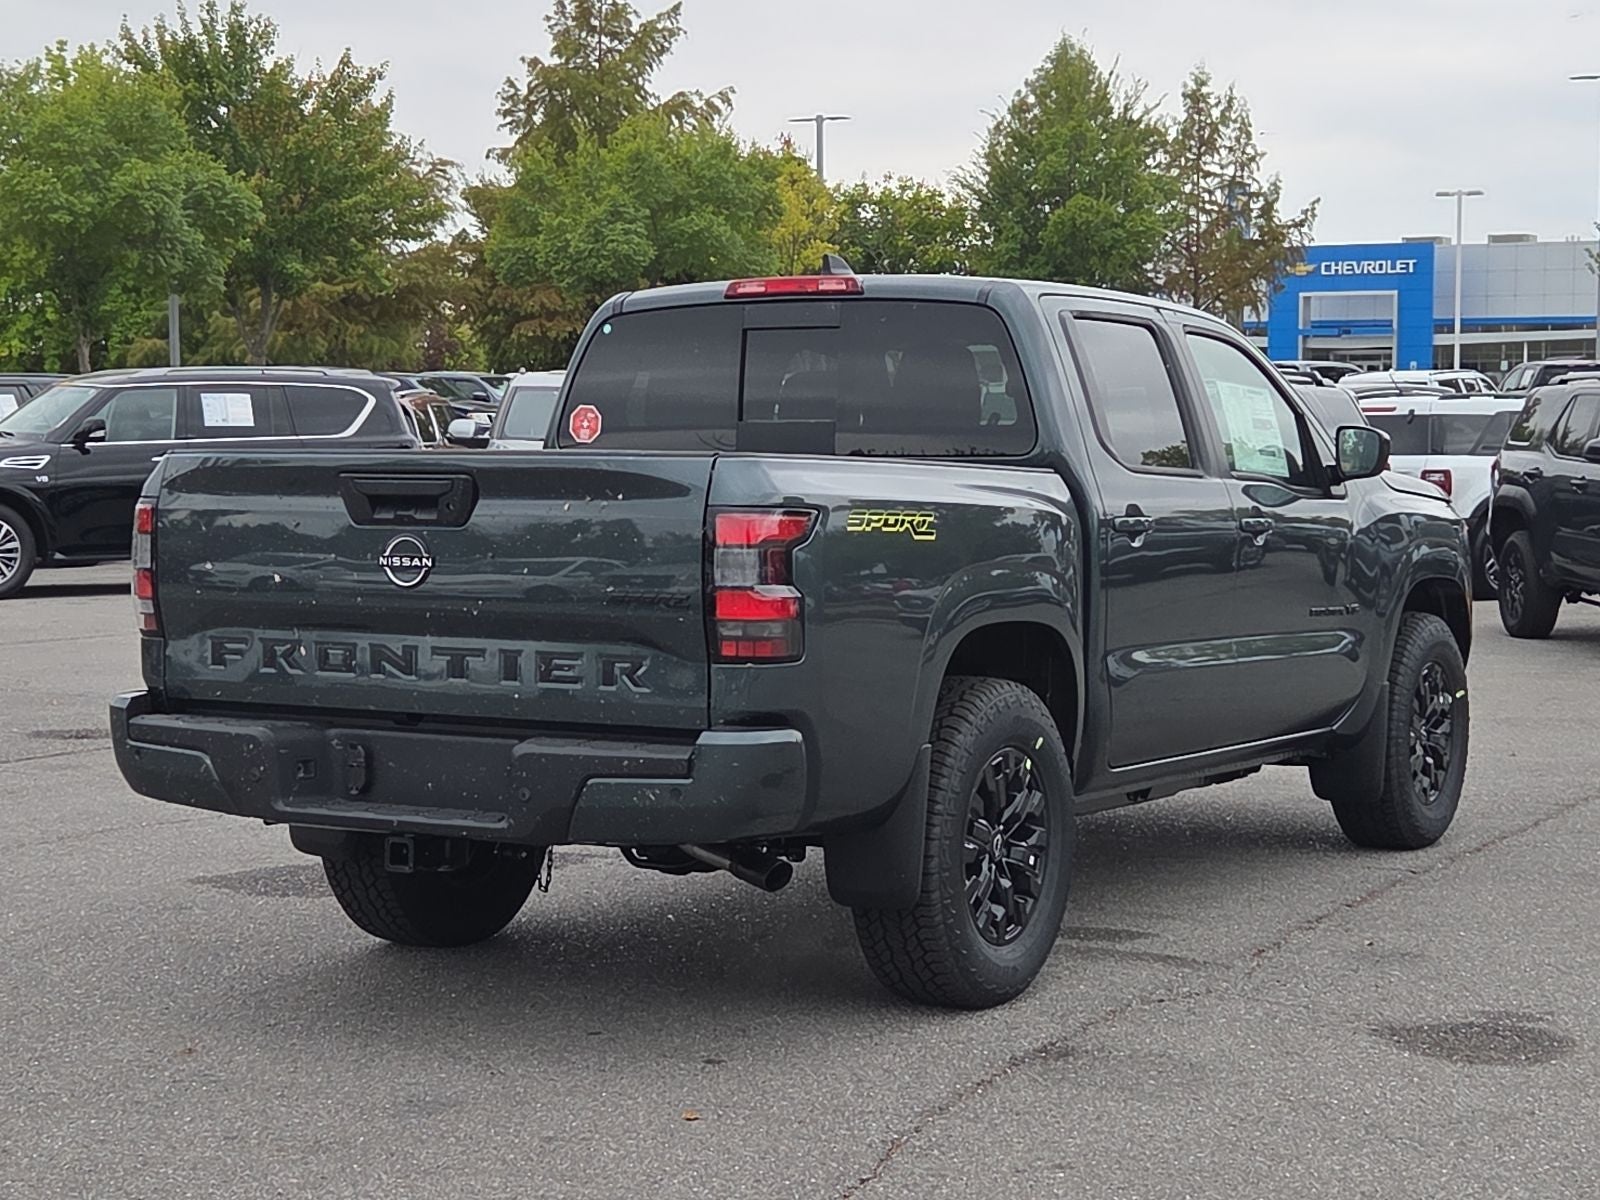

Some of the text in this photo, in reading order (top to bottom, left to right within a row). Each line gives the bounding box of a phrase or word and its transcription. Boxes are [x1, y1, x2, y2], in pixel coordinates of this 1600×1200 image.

[1320, 259, 1418, 275] CHEVROLET
[379, 556, 432, 567] NISSAN
[207, 634, 652, 693] FRONTIER
